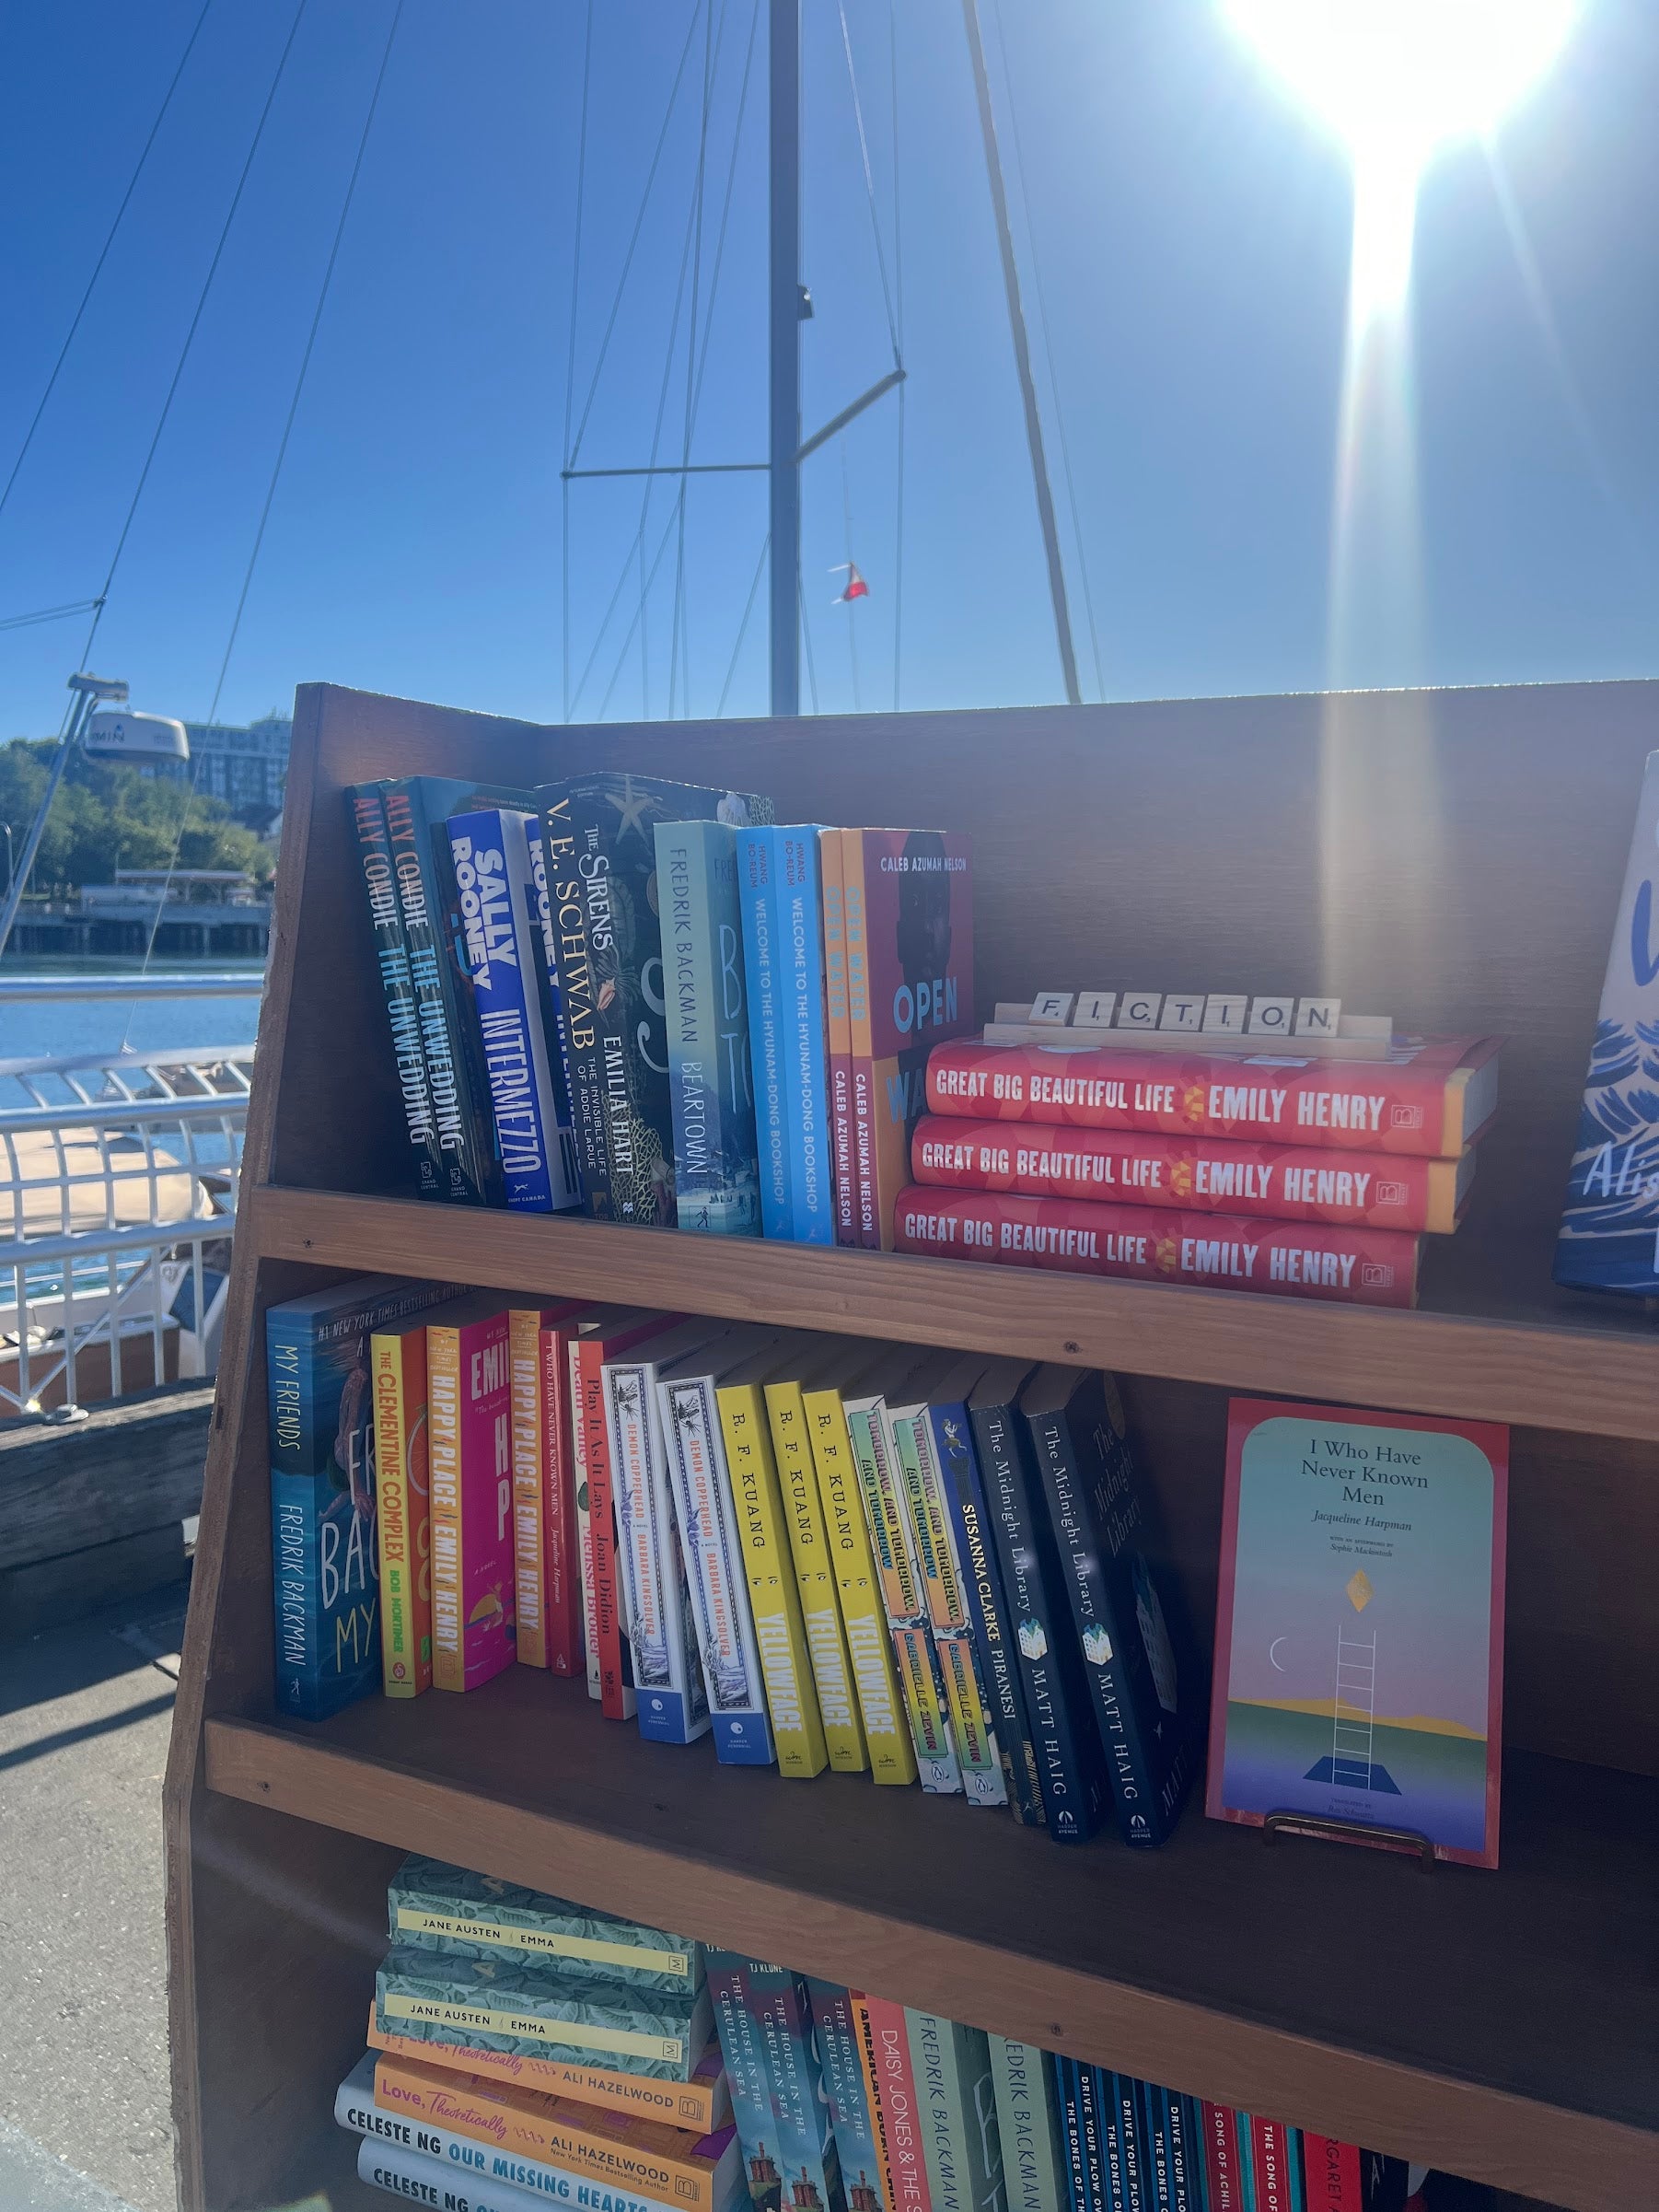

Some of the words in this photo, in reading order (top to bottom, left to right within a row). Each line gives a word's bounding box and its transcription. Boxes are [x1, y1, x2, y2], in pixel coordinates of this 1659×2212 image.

[385, 795, 415, 842] ALLY
[546, 797, 572, 826] V.
[550, 835, 575, 870] E.
[585, 823, 598, 852] THE
[784, 840, 795, 886] BO-REUM
[795, 843, 806, 883] HWANG
[880, 856, 909, 872] CALEB
[911, 856, 942, 872] AZUMAH
[944, 857, 967, 872] NELSON
[395, 851, 429, 932] CONDIE
[451, 836, 493, 991] ROONEY
[475, 848, 517, 967] SALLY
[578, 853, 614, 951] SIRENS
[670, 848, 691, 936] FREDRIK
[792, 897, 806, 969] WELCOME
[846, 886, 862, 942] OPEN
[410, 945, 441, 993] THE
[555, 880, 596, 1050] SCHWAB
[795, 972, 807, 990] TO
[850, 952, 866, 1021] WATER
[677, 942, 699, 1042] BACKMAN
[797, 994, 808, 1019] THE
[893, 976, 958, 1034] OPEN
[1041, 997, 1328, 1027] FICTION
[418, 999, 465, 1151] UNWEDDING
[577, 1065, 586, 1082] OF
[587, 1057, 597, 1080] THE
[603, 1036, 628, 1112] EMILIA
[797, 1022, 814, 1132] HYUNAM-DONG
[481, 1009, 541, 1174] INTERMEZZO
[579, 1089, 592, 1123] ADDIE
[590, 1084, 604, 1143] INVISIBLE
[855, 1073, 867, 1115] CALEB
[936, 1069, 988, 1097] GREAT
[993, 1074, 1024, 1100] BIG
[1030, 1076, 1128, 1109] BEAUTIFUL
[1134, 1083, 1175, 1113] LIFE
[1209, 1085, 1287, 1124] EMILY
[1297, 1090, 1386, 1131] HENRY
[681, 1061, 708, 1174] BEARTOWN
[583, 1129, 597, 1170] LARUE
[597, 1149, 608, 1177] LIFE
[612, 1121, 634, 1175] HART
[857, 1121, 870, 1175] AZUMAH
[803, 1135, 818, 1213] BOOKSHOP
[521, 1194, 546, 1203] CANADA
[860, 1181, 873, 1231] NELSON
[905, 1213, 957, 1241] GREAT
[963, 1219, 992, 1247] BIG
[1001, 1223, 1099, 1259] BEAUTIFUL
[1107, 1234, 1147, 1264] LIFE
[1181, 1238, 1259, 1277] EMILY
[1270, 1247, 1357, 1288] HENRY
[319, 1325, 330, 1342] #1
[332, 1317, 352, 1337] NEW
[354, 1310, 374, 1333] YORK
[377, 1305, 398, 1323] TIMES
[400, 1289, 443, 1319] BESTSELLING
[274, 1345, 299, 1374] MY
[379, 1351, 391, 1369] THE
[545, 1351, 553, 1379] WHO
[275, 1380, 300, 1450] FRIENDS
[432, 1376, 456, 1442] HAPPY
[585, 1380, 600, 1411] Play
[377, 1374, 401, 1476] CLEMENTINE
[548, 1412, 557, 1445] NEVER
[589, 1419, 602, 1430] It
[818, 1414, 831, 1435] R.
[550, 1449, 558, 1492] KNOWN
[591, 1440, 604, 1457] As
[592, 1463, 605, 1474] It
[690, 1439, 704, 1473] DEMON
[824, 1445, 837, 1463] F.
[1310, 1438, 1317, 1454] I
[1325, 1440, 1369, 1461] Who
[1376, 1446, 1421, 1465] Have
[433, 1443, 457, 1508] PLACE
[862, 1459, 875, 1488] AND
[1301, 1460, 1356, 1481] Never
[1362, 1466, 1429, 1489] Known
[551, 1494, 559, 1516] MEN
[590, 1482, 606, 1519] Lays
[695, 1476, 713, 1537] COPPERHEAD
[830, 1473, 854, 1551] KUANG
[883, 1497, 899, 1531] AND
[1341, 1486, 1385, 1506] Men
[280, 1505, 304, 1576] FREDRIK
[382, 1481, 404, 1563] COMPLEX
[868, 1490, 893, 1570] TOMORROW
[1311, 1509, 1362, 1527] Jacqueline
[1364, 1516, 1411, 1531] Harpman
[434, 1526, 458, 1584] EMILY
[551, 1526, 561, 1566] Jacqueline
[597, 1533, 609, 1572] Joan
[1329, 1543, 1352, 1554] Sophie
[1353, 1546, 1393, 1557] Mackintosh
[389, 1569, 401, 1593] BOB
[552, 1568, 562, 1603] Harpman
[282, 1580, 307, 1666] BACKMAN
[391, 1598, 404, 1653] MORTIMER
[436, 1589, 458, 1652] HENRY
[599, 1578, 613, 1635] Didion
[706, 1553, 720, 1595] BARBARA
[713, 1596, 731, 1657] KINGSOLVER
[962, 1504, 988, 1579] SUSANNA
[978, 1581, 1002, 1642] CLARKE
[991, 1649, 1016, 1719] PIRANESI
[1045, 1426, 1061, 1459] The
[1053, 1466, 1081, 1546] Midnight
[1073, 1552, 1096, 1618] Library
[1098, 1673, 1123, 1733] MATT
[1114, 1743, 1138, 1799] HAIG
[848, 1614, 896, 1736] YELLOWFACE
[904, 1633, 929, 1707] GABRIELLE
[919, 1710, 937, 1751] ZEVIN
[423, 1918, 452, 1931] JANE
[456, 1924, 501, 1939] AUSTEN
[520, 1935, 554, 1948] EMMA
[774, 1997, 787, 2027] THE
[763, 2012, 784, 2088] CERULEAN
[778, 2093, 789, 2120] SEA
[781, 2032, 796, 2078] HOUSE
[882, 2030, 904, 2081] DAISY
[790, 2085, 800, 2101] IN
[920, 2018, 945, 2101] FREDRIK
[933, 2110, 959, 2210] BACKMAN
[1067, 2101, 1076, 2125] THE
[1082, 2076, 1092, 2113] DRIVE
[382, 2078, 425, 2109] Love,
[426, 2090, 507, 2139] Theoretically
[551, 2136, 572, 2151] ALI
[578, 2144, 669, 2183] HAZELWOOD
[794, 2107, 806, 2136] THE
[889, 2085, 912, 2147] JONES
[1085, 2120, 1096, 2151] YOUR
[1264, 2125, 1274, 2150] THE
[347, 2108, 411, 2145] CELESTE
[417, 2131, 441, 2154] NG
[448, 2143, 486, 2171] OUR
[493, 2158, 570, 2198] MISSING
[551, 2148, 565, 2159] New
[567, 2153, 583, 2164] York
[585, 2159, 604, 2171] Times
[605, 2165, 643, 2184] Bestselling
[645, 2179, 668, 2193] Author
[899, 2150, 914, 2165] &
[1069, 2129, 1081, 2170] BONES
[901, 2168, 921, 2200] THE
[1074, 2176, 1084, 2192] OF
[1090, 2158, 1101, 2192] PLOW
[1266, 2154, 1277, 2191] SONG
